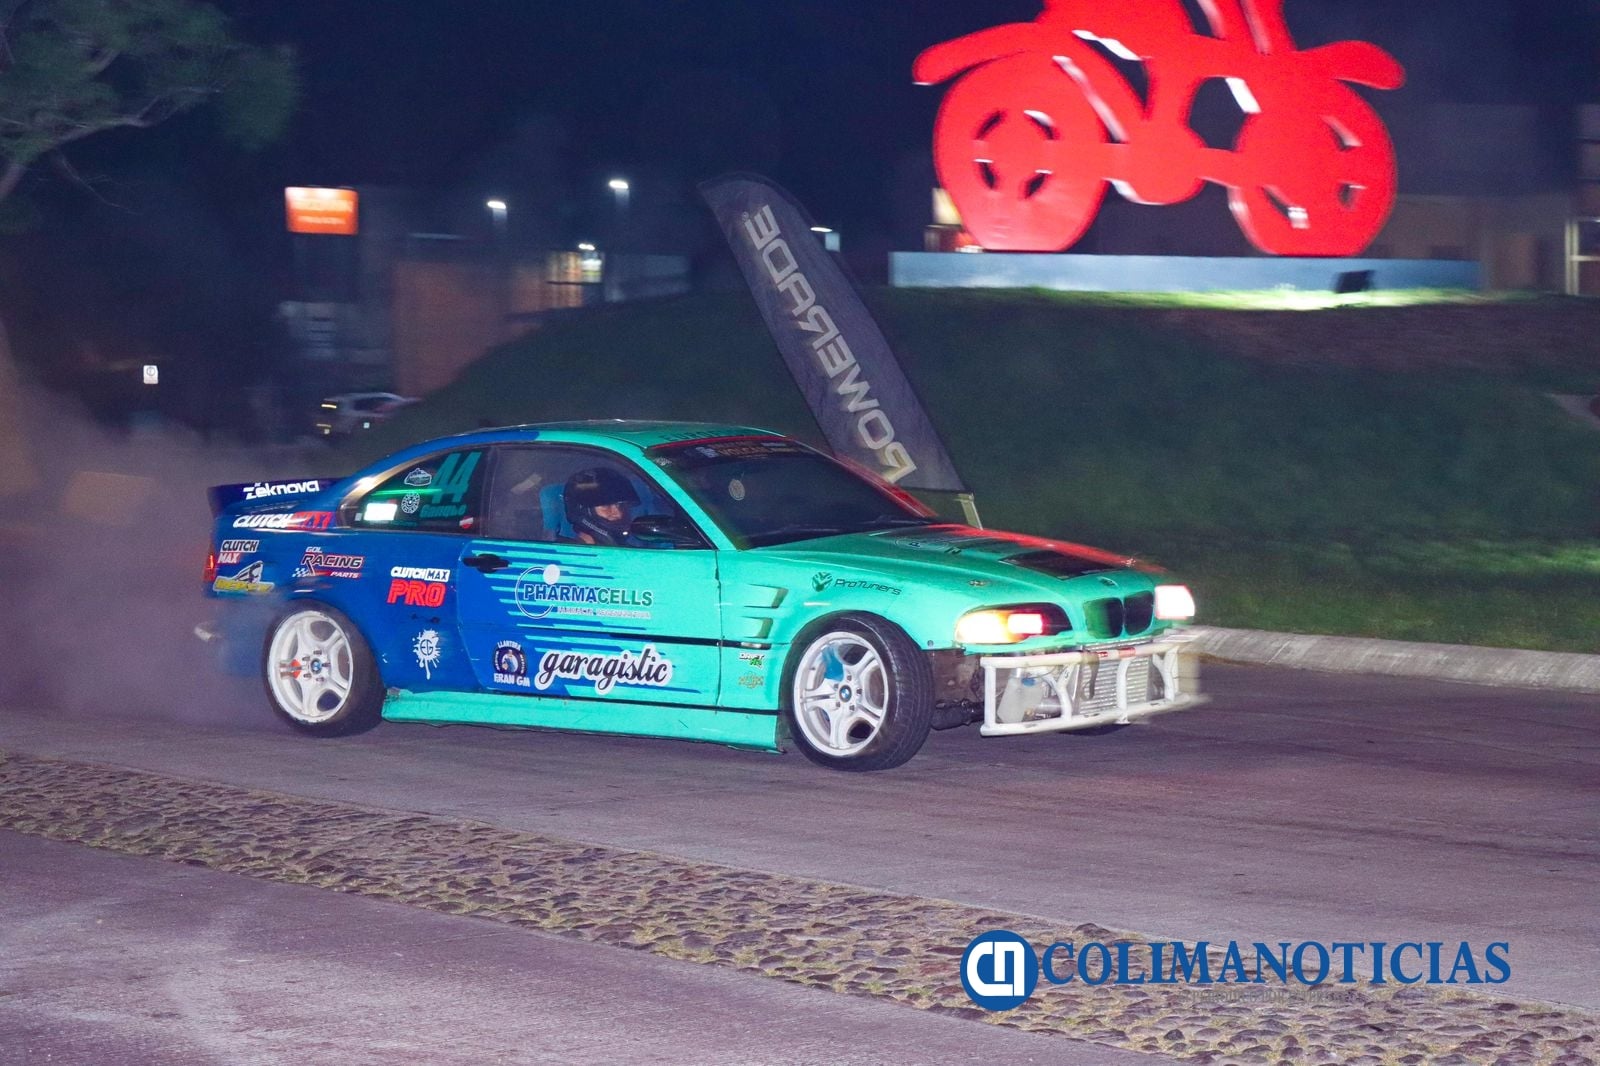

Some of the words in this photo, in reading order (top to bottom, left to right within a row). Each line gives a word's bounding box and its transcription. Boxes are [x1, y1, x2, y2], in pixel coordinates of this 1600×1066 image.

[221, 540, 258, 552] CLUTCH
[301, 554, 363, 574] RACING
[330, 571, 360, 579] PARTS
[387, 580, 446, 607] PRO
[524, 583, 653, 607] PHARMACELLS
